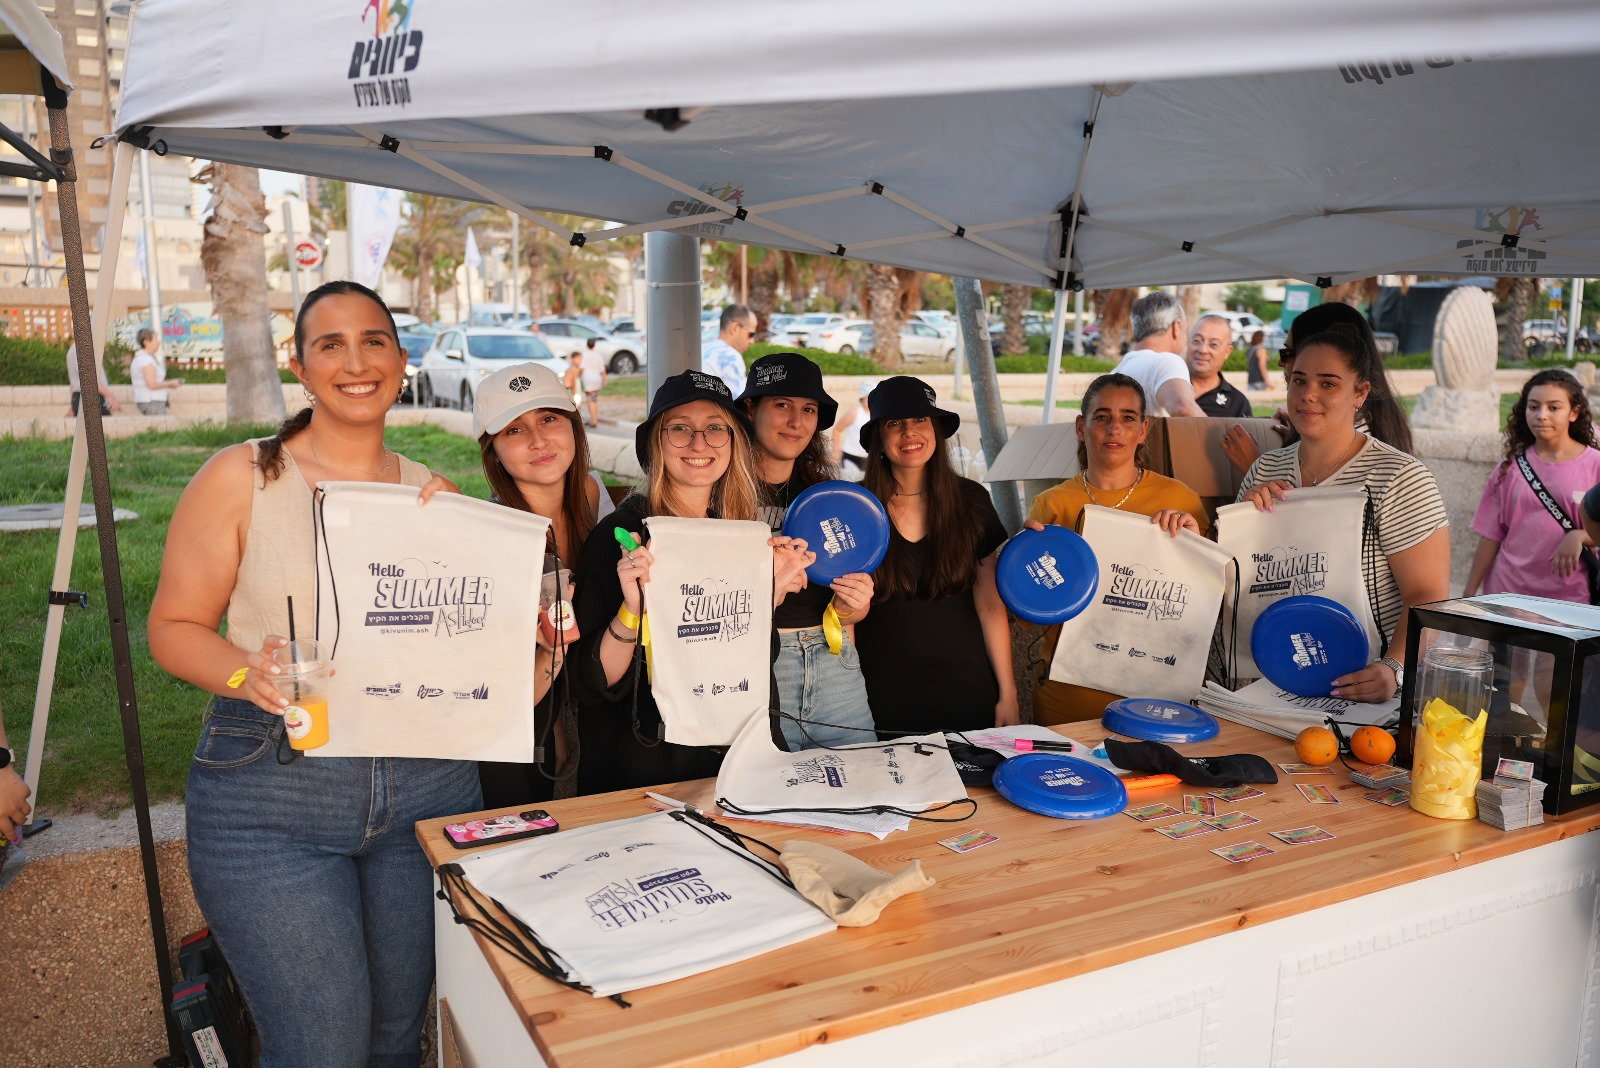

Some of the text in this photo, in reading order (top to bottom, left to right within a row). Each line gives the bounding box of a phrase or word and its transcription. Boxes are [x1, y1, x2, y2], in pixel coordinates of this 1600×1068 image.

[348, 30, 423, 79] כיוונים
[1539, 491, 1563, 520] adidas
[1251, 553, 1274, 563] Hello
[1255, 551, 1329, 583] SUMMER
[367, 562, 405, 578] Hello
[1110, 563, 1134, 577] Hello
[374, 576, 495, 610] SUMMER
[680, 583, 705, 596] Hello
[1110, 574, 1192, 605] SUMMER
[682, 590, 753, 622] SUMMER
[388, 615, 400, 623] את
[401, 613, 430, 623] מקבלים
[591, 878, 714, 932] SUMMER
[694, 891, 732, 905] Hello
